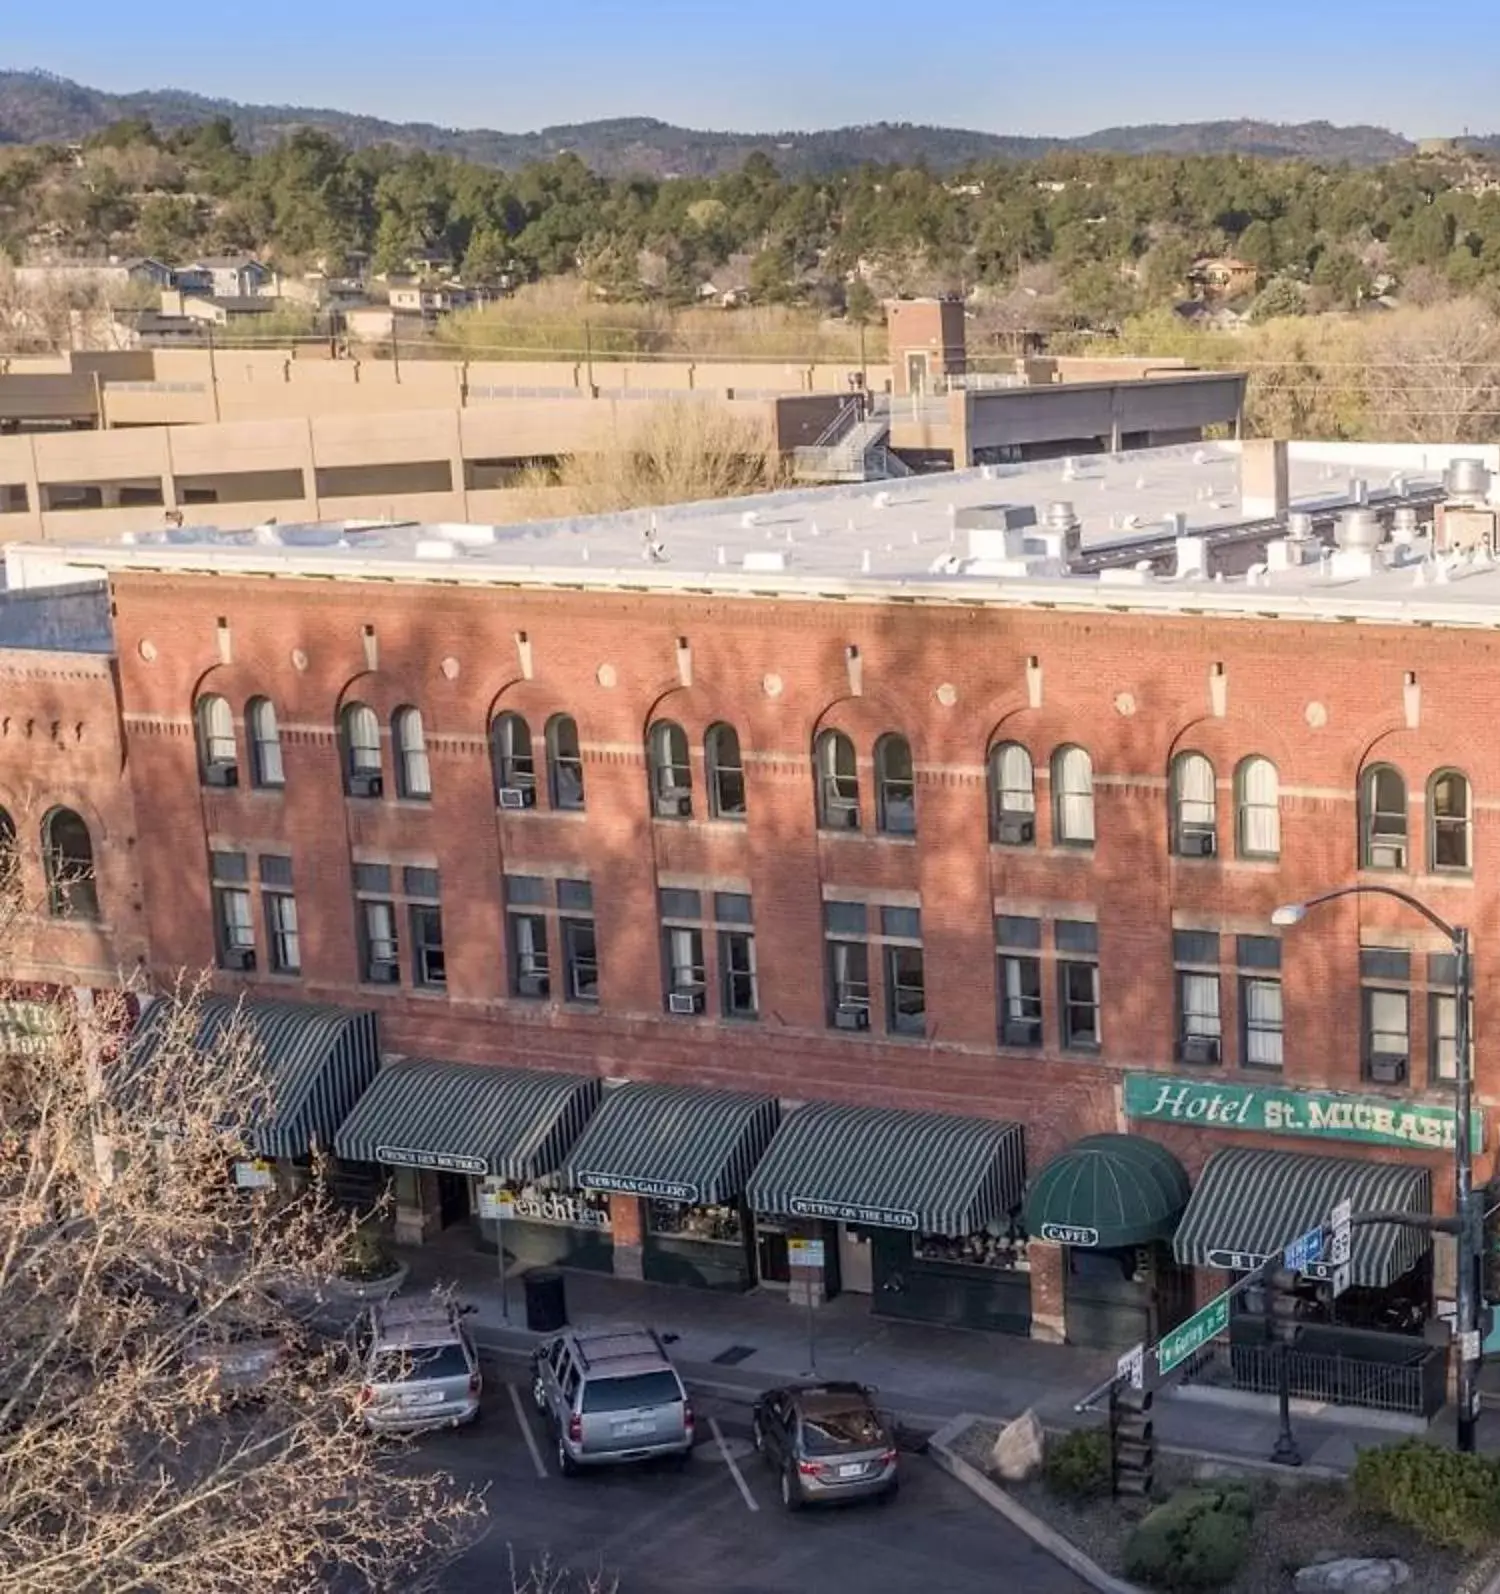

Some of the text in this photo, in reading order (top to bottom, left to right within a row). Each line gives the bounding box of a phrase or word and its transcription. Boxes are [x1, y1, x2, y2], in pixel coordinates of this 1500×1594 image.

[1145, 1085, 1253, 1124] Hotel
[1264, 1101, 1304, 1129] St.
[587, 1176, 687, 1197] NEWMAN GALLERY
[840, 1206, 856, 1218] ON
[859, 1209, 880, 1221] THE
